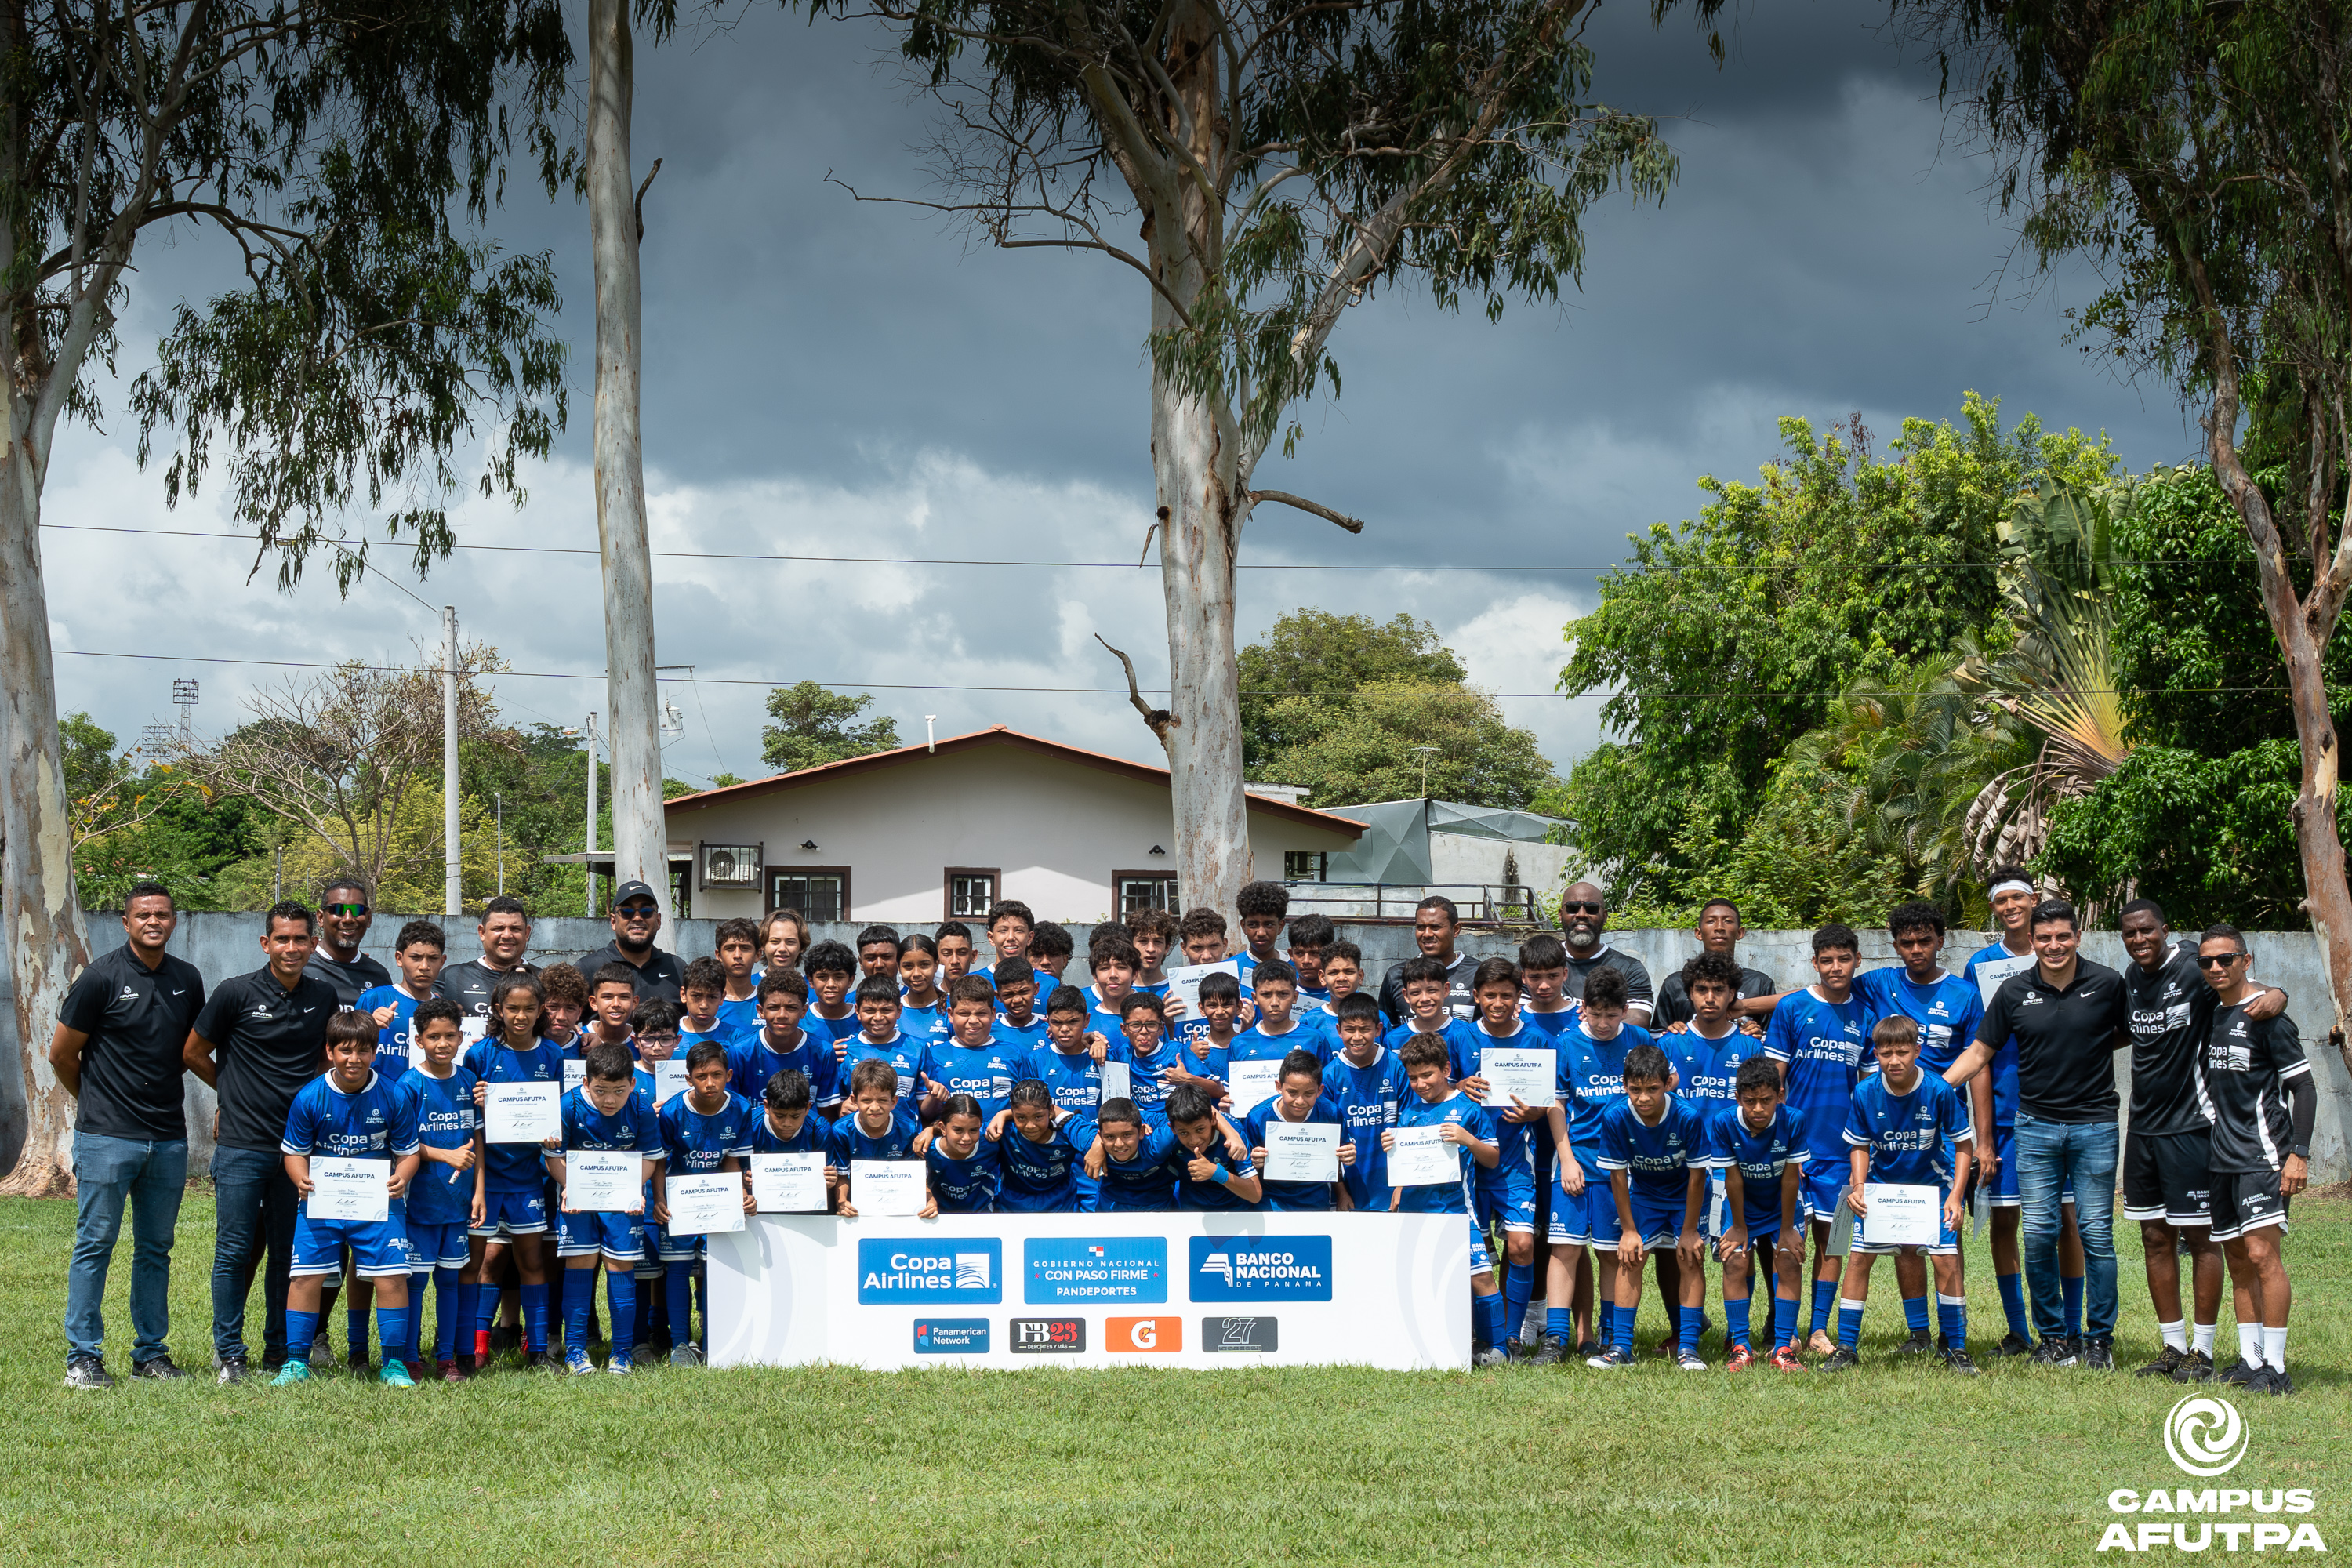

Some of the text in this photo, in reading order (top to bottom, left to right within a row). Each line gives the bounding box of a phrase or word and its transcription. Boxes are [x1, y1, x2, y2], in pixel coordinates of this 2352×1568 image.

[1290, 1004, 1308, 1013] AMPUS
[2132, 1010, 2164, 1024] Copa
[1184, 1023, 1210, 1035] Cop
[1809, 1036, 1846, 1050] Copa
[376, 1043, 409, 1058] Airli
[1795, 1049, 1844, 1062] Airlines
[950, 1077, 990, 1090] Copa
[1588, 1075, 1624, 1087] Copa
[1691, 1076, 1726, 1087] Copa
[1055, 1087, 1085, 1097] Copa
[1576, 1085, 1626, 1098] Airlines
[1676, 1087, 1725, 1098] Airlines
[1052, 1097, 1087, 1105] irlines
[1347, 1105, 1381, 1115] Copa
[428, 1112, 458, 1121] Copa
[419, 1121, 459, 1132] Airlines
[329, 1134, 368, 1145] Copa
[1883, 1131, 1917, 1140] Copa
[1872, 1140, 1917, 1151] Airlines
[690, 1150, 720, 1160] Copa
[1634, 1156, 1671, 1165] Copa
[1739, 1162, 1771, 1171] Copa
[941, 1182, 969, 1192] Copa
[2249, 1195, 2272, 1204] NACIONAL
[891, 1254, 952, 1272] Copa
[1236, 1253, 1294, 1265] BANCO
[1045, 1270, 1148, 1281] CON PASO FIRME
[1236, 1265, 1321, 1278] NACIONAL
[863, 1272, 952, 1289] Airlines
[1057, 1287, 1137, 1296] PANDEPORTES
[933, 1327, 986, 1336] Panamerican
[1018, 1322, 1077, 1343] FB23
[1131, 1320, 1156, 1349] G
[1222, 1317, 1257, 1344] 27
[933, 1336, 971, 1345] Network
